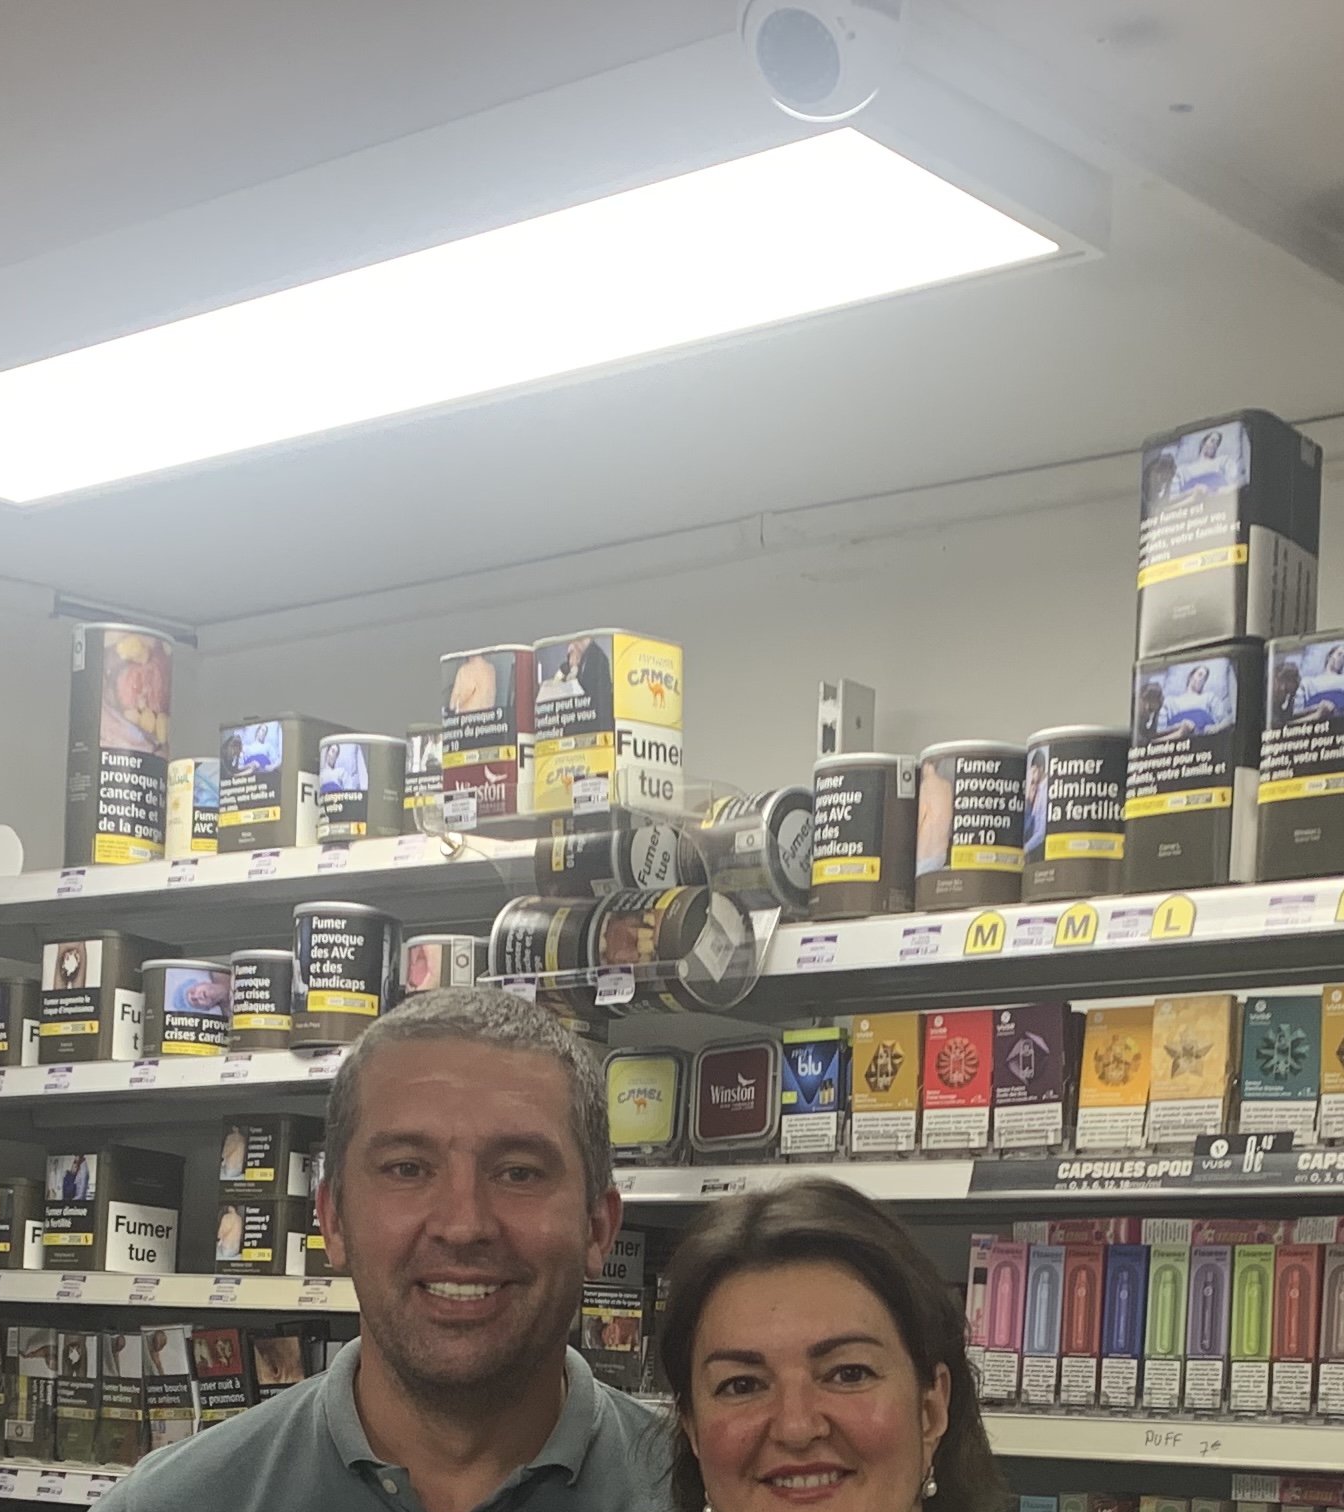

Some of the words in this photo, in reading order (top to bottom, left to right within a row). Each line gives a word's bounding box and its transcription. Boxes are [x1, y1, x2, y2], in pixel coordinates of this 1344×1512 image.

[628, 669, 680, 696] CAMEL
[101, 751, 143, 769] Fumer
[957, 757, 1001, 774] Fumer
[1050, 757, 1104, 776] Fumer
[100, 769, 159, 792] provoque
[639, 770, 673, 801] tue
[956, 777, 1020, 796] provoque
[1048, 778, 1119, 799] diminue
[100, 786, 142, 802] cancer
[955, 795, 1007, 811] cancers
[1010, 795, 1024, 811] du
[99, 801, 146, 822] bouche
[1048, 802, 1062, 822] la
[98, 817, 114, 832] de
[118, 818, 131, 834] la
[954, 814, 1011, 831] poumon
[953, 831, 974, 846] sur
[978, 829, 995, 845] 10
[312, 916, 346, 931] Fumer
[1062, 914, 1091, 938] M
[1163, 906, 1182, 933] L
[311, 932, 365, 950] provoque
[973, 924, 999, 947] M
[311, 945, 328, 960] des
[330, 945, 356, 961] AVC
[310, 961, 321, 974] et
[322, 960, 343, 975] des
[309, 973, 366, 992] handicaps
[797, 1053, 822, 1078] blu
[617, 1087, 664, 1104] CAMEL
[710, 1083, 756, 1105] Winston
[1058, 1161, 1144, 1179] CAPSULES
[114, 1213, 173, 1240] Fumer
[127, 1243, 157, 1265] tue
[1144, 1429, 1182, 1448] PUFF
